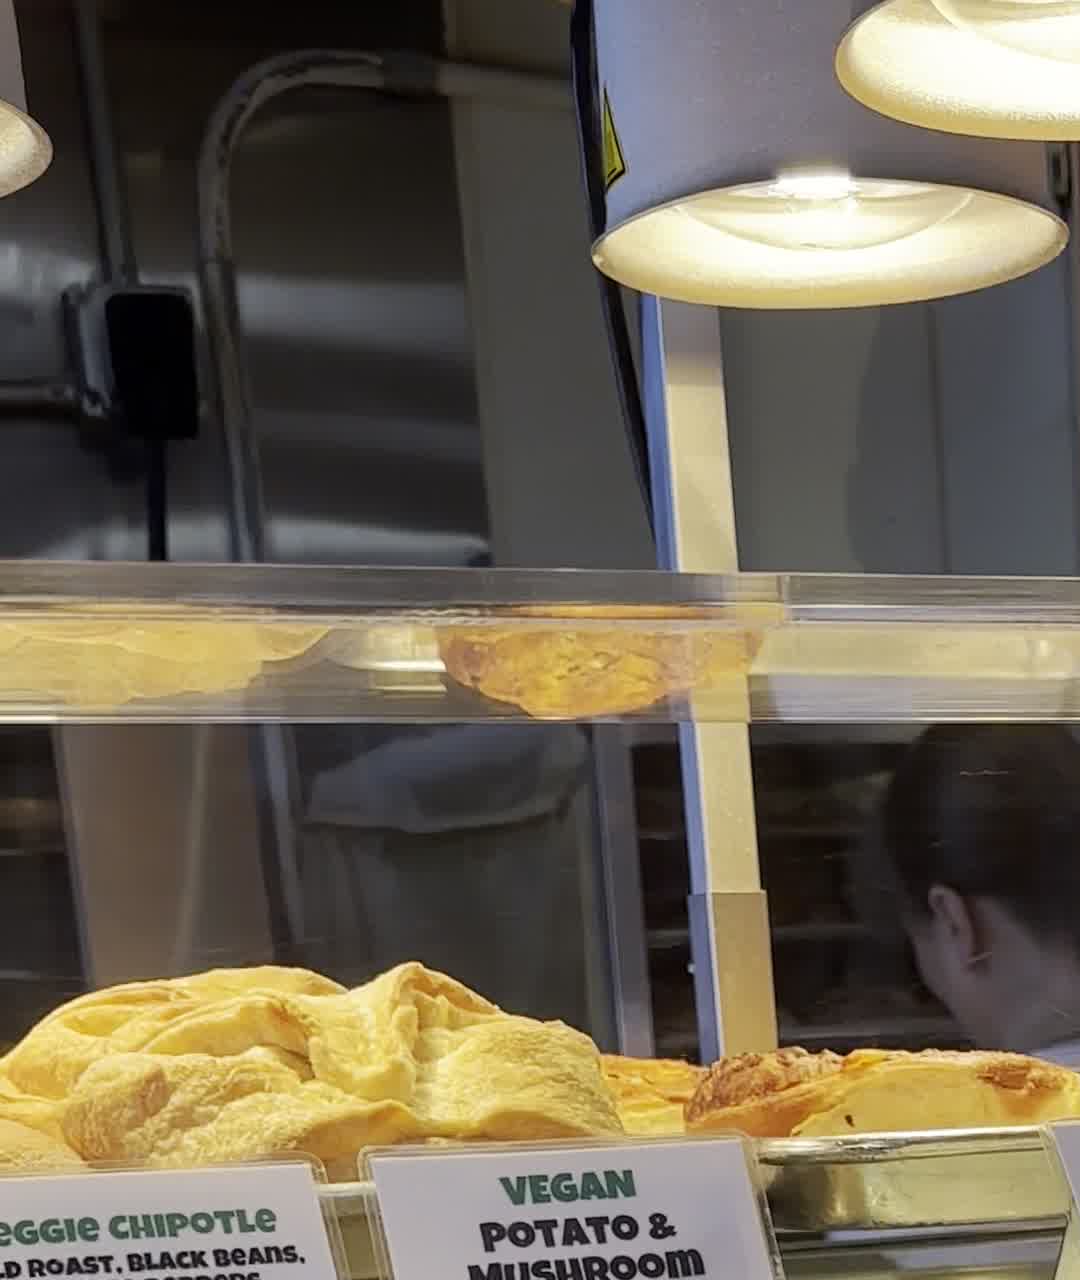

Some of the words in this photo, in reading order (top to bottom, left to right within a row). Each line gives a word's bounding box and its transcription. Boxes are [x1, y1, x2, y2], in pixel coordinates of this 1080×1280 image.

[498, 1169, 638, 1206] VEGAN
[479, 1215, 640, 1253] POTATO
[648, 1212, 677, 1241] &
[128, 1249, 208, 1272] BLACK
